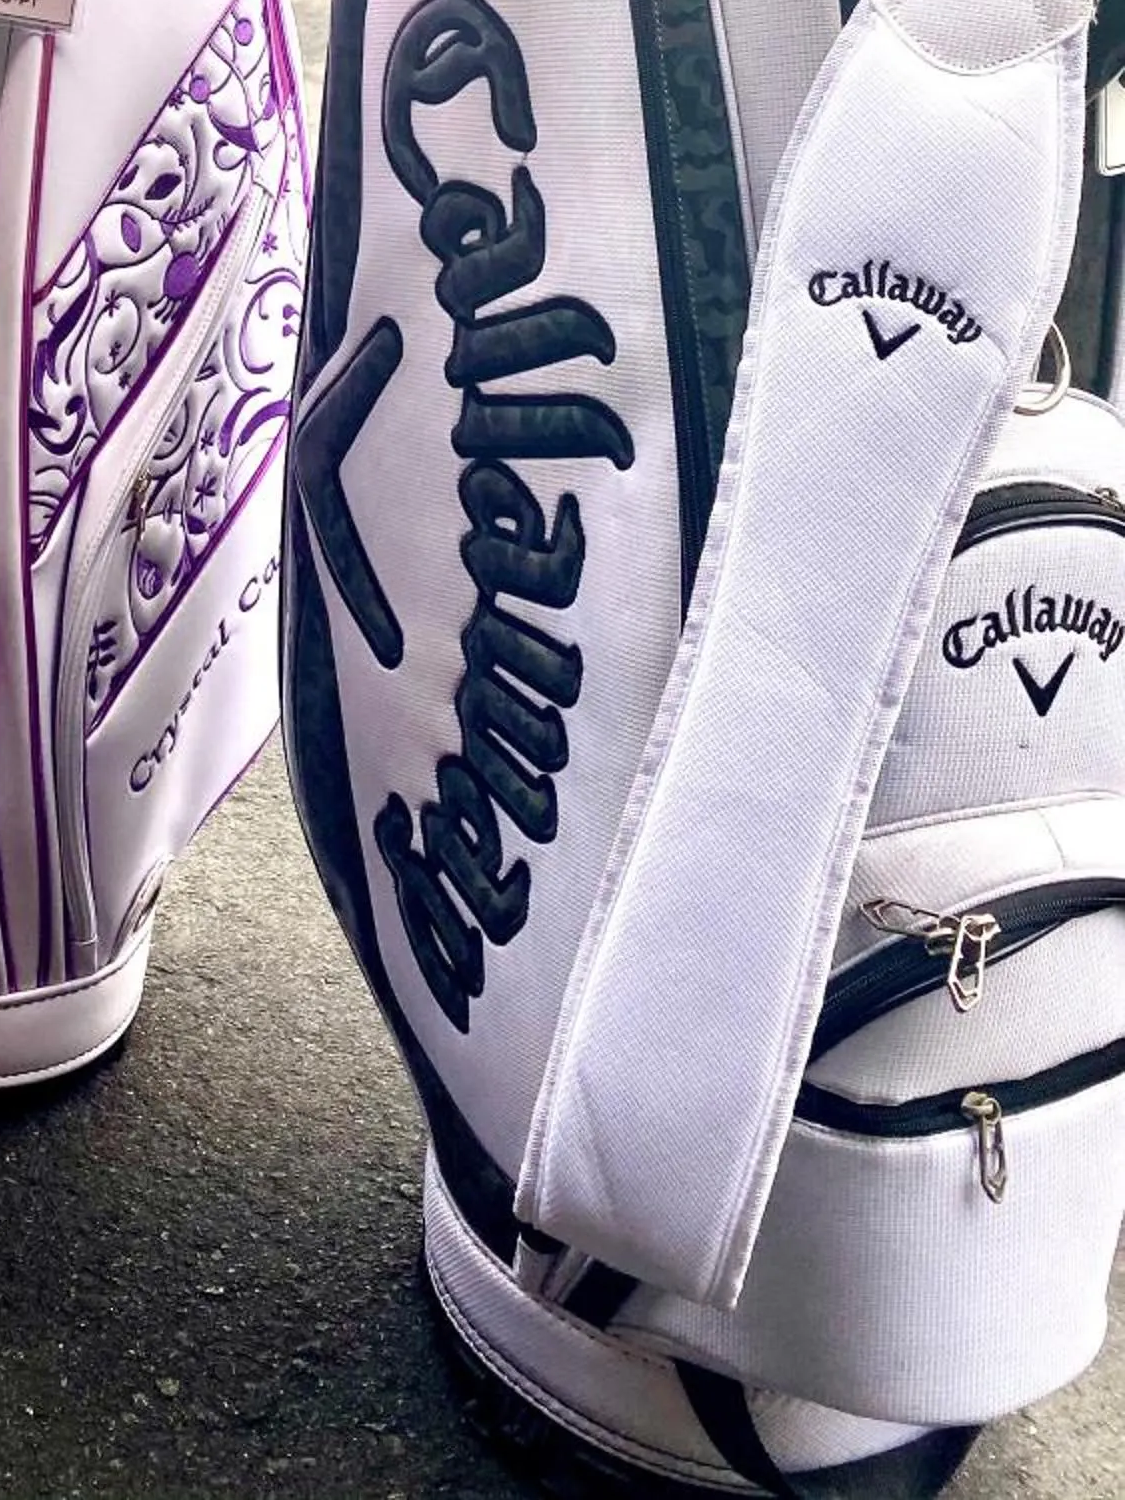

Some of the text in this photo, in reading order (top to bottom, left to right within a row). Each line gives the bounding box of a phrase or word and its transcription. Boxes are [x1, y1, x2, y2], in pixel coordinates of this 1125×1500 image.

[808, 259, 984, 346] Callaway
[238, 554, 280, 613] Ca
[942, 584, 1125, 670] Callaway
